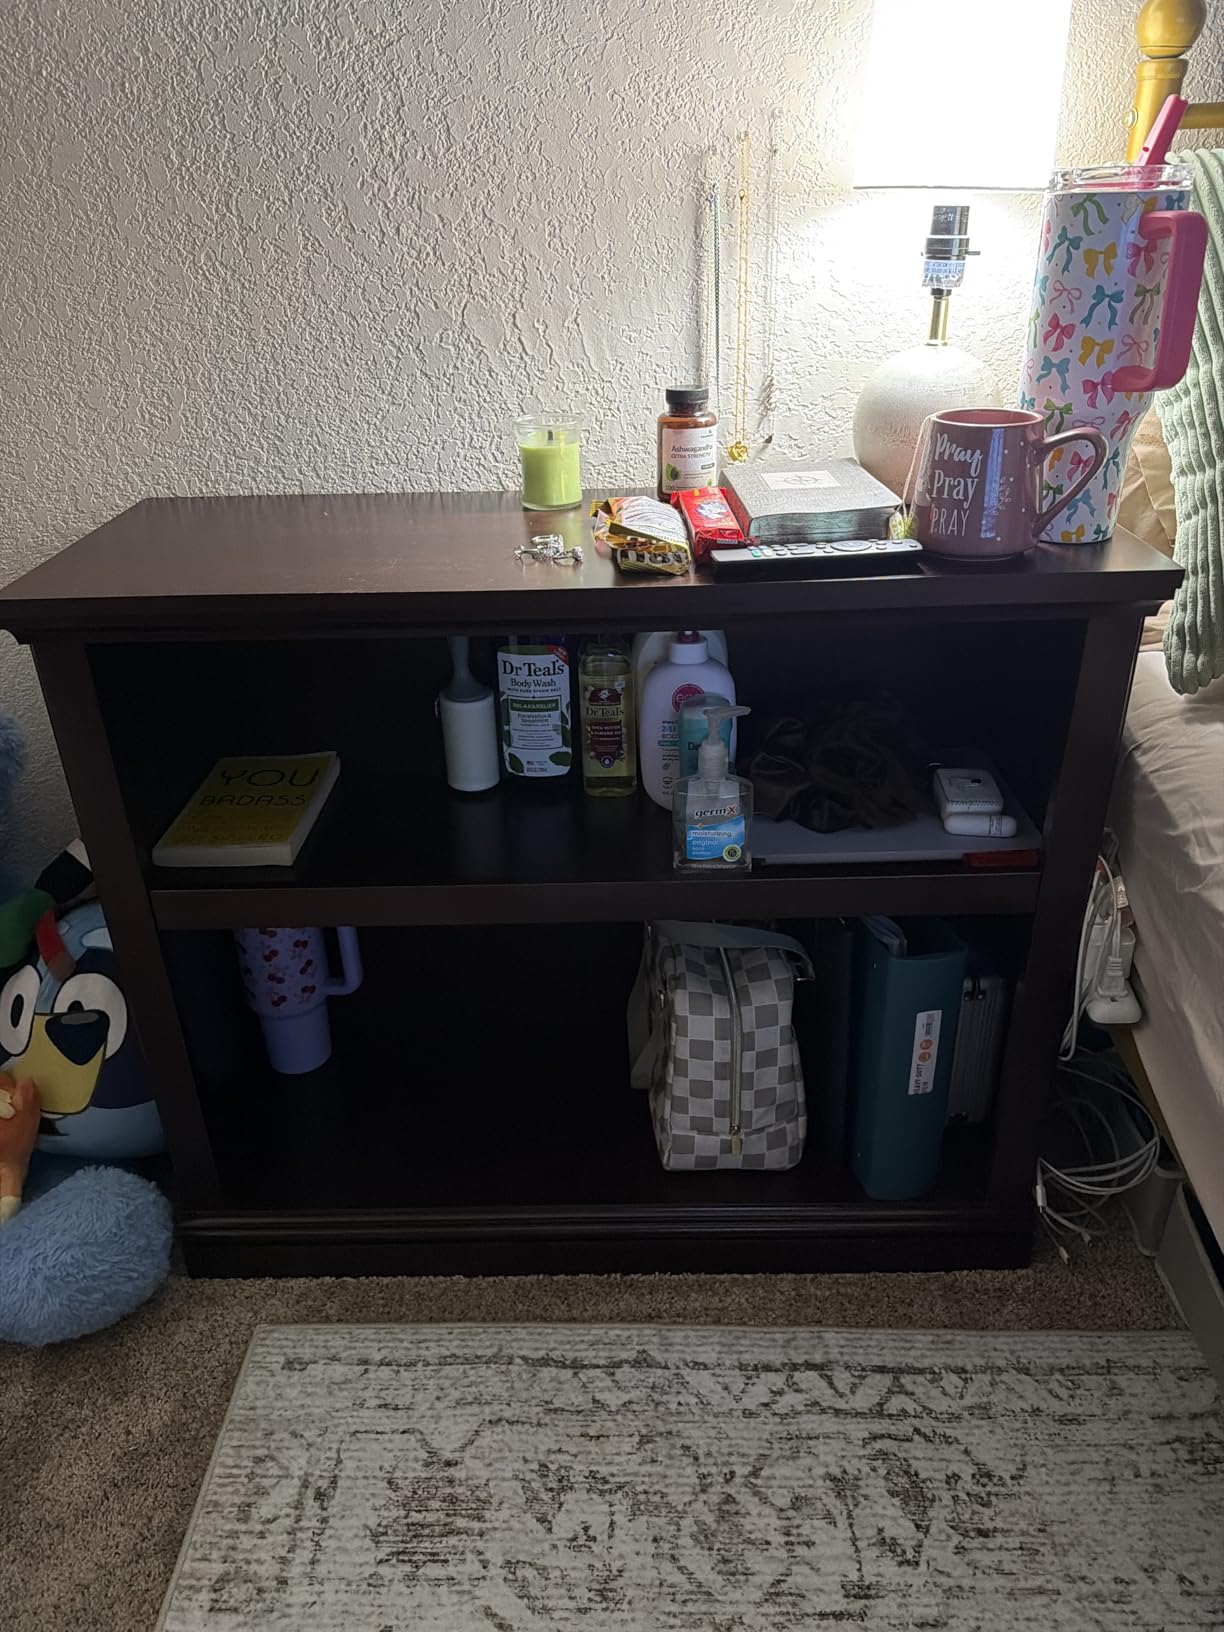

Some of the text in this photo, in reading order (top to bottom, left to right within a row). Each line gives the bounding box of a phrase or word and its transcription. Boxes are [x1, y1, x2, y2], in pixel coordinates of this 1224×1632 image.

[934, 432, 984, 477] Pray
[931, 468, 979, 509] Pray
[930, 504, 970, 536] PRAY
[502, 659, 565, 676] Dr Teal's
[510, 678, 556, 689] Body Wash
[586, 706, 624, 717] Dr Teal's
[220, 768, 320, 786] YOU
[199, 794, 306, 806] BADASS
[692, 830, 732, 838] moisturizing
